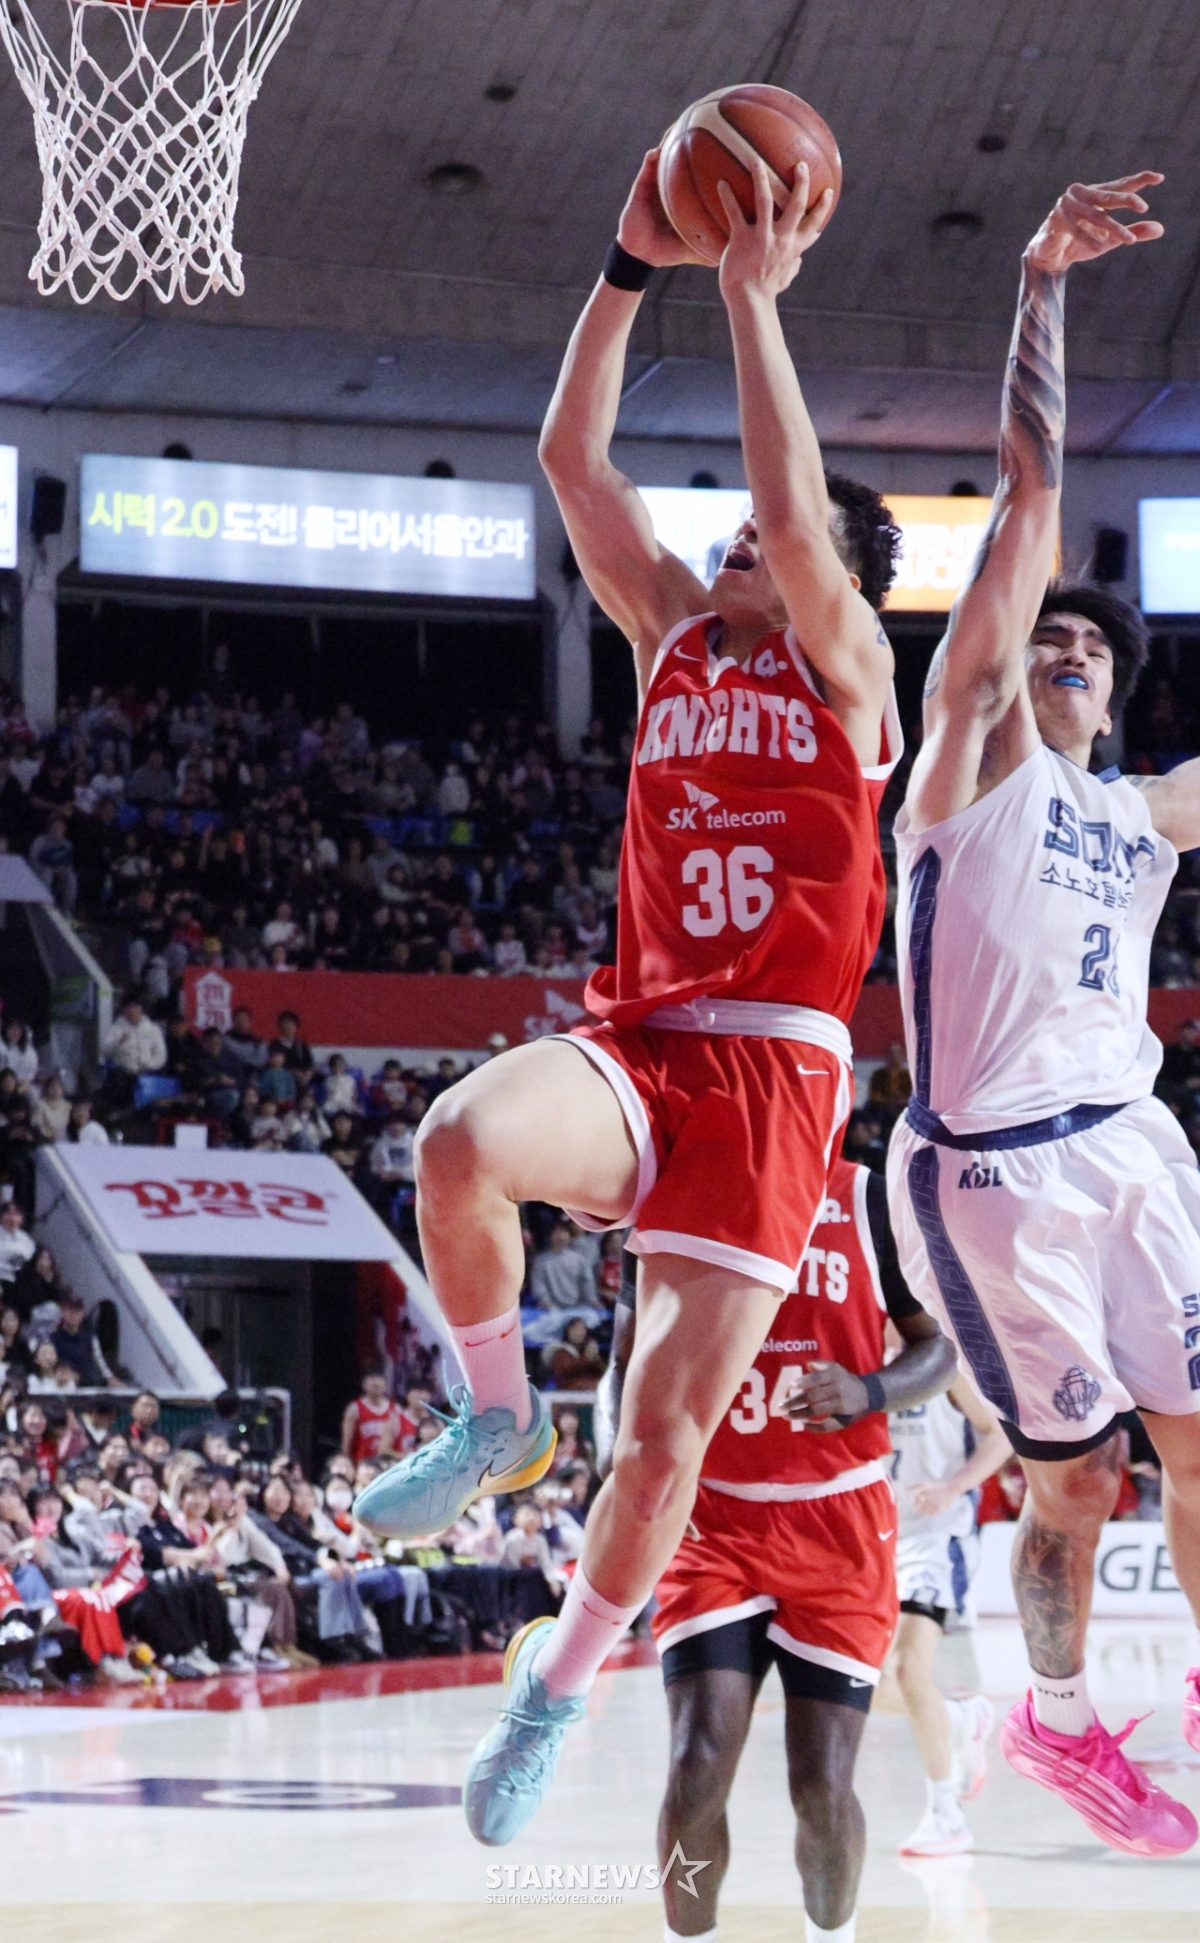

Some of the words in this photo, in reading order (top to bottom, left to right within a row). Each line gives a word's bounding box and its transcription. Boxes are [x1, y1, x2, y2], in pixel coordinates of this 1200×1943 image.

[88, 491, 156, 537] 시력
[160, 496, 219, 539] 2.0
[220, 501, 298, 546] 도전!
[637, 687, 819, 766] KNIGHTS
[665, 807, 698, 830] SK
[706, 809, 786, 829] telecom
[681, 845, 775, 938] 36
[760, 1337, 818, 1353] elecom
[729, 1364, 805, 1434] 34
